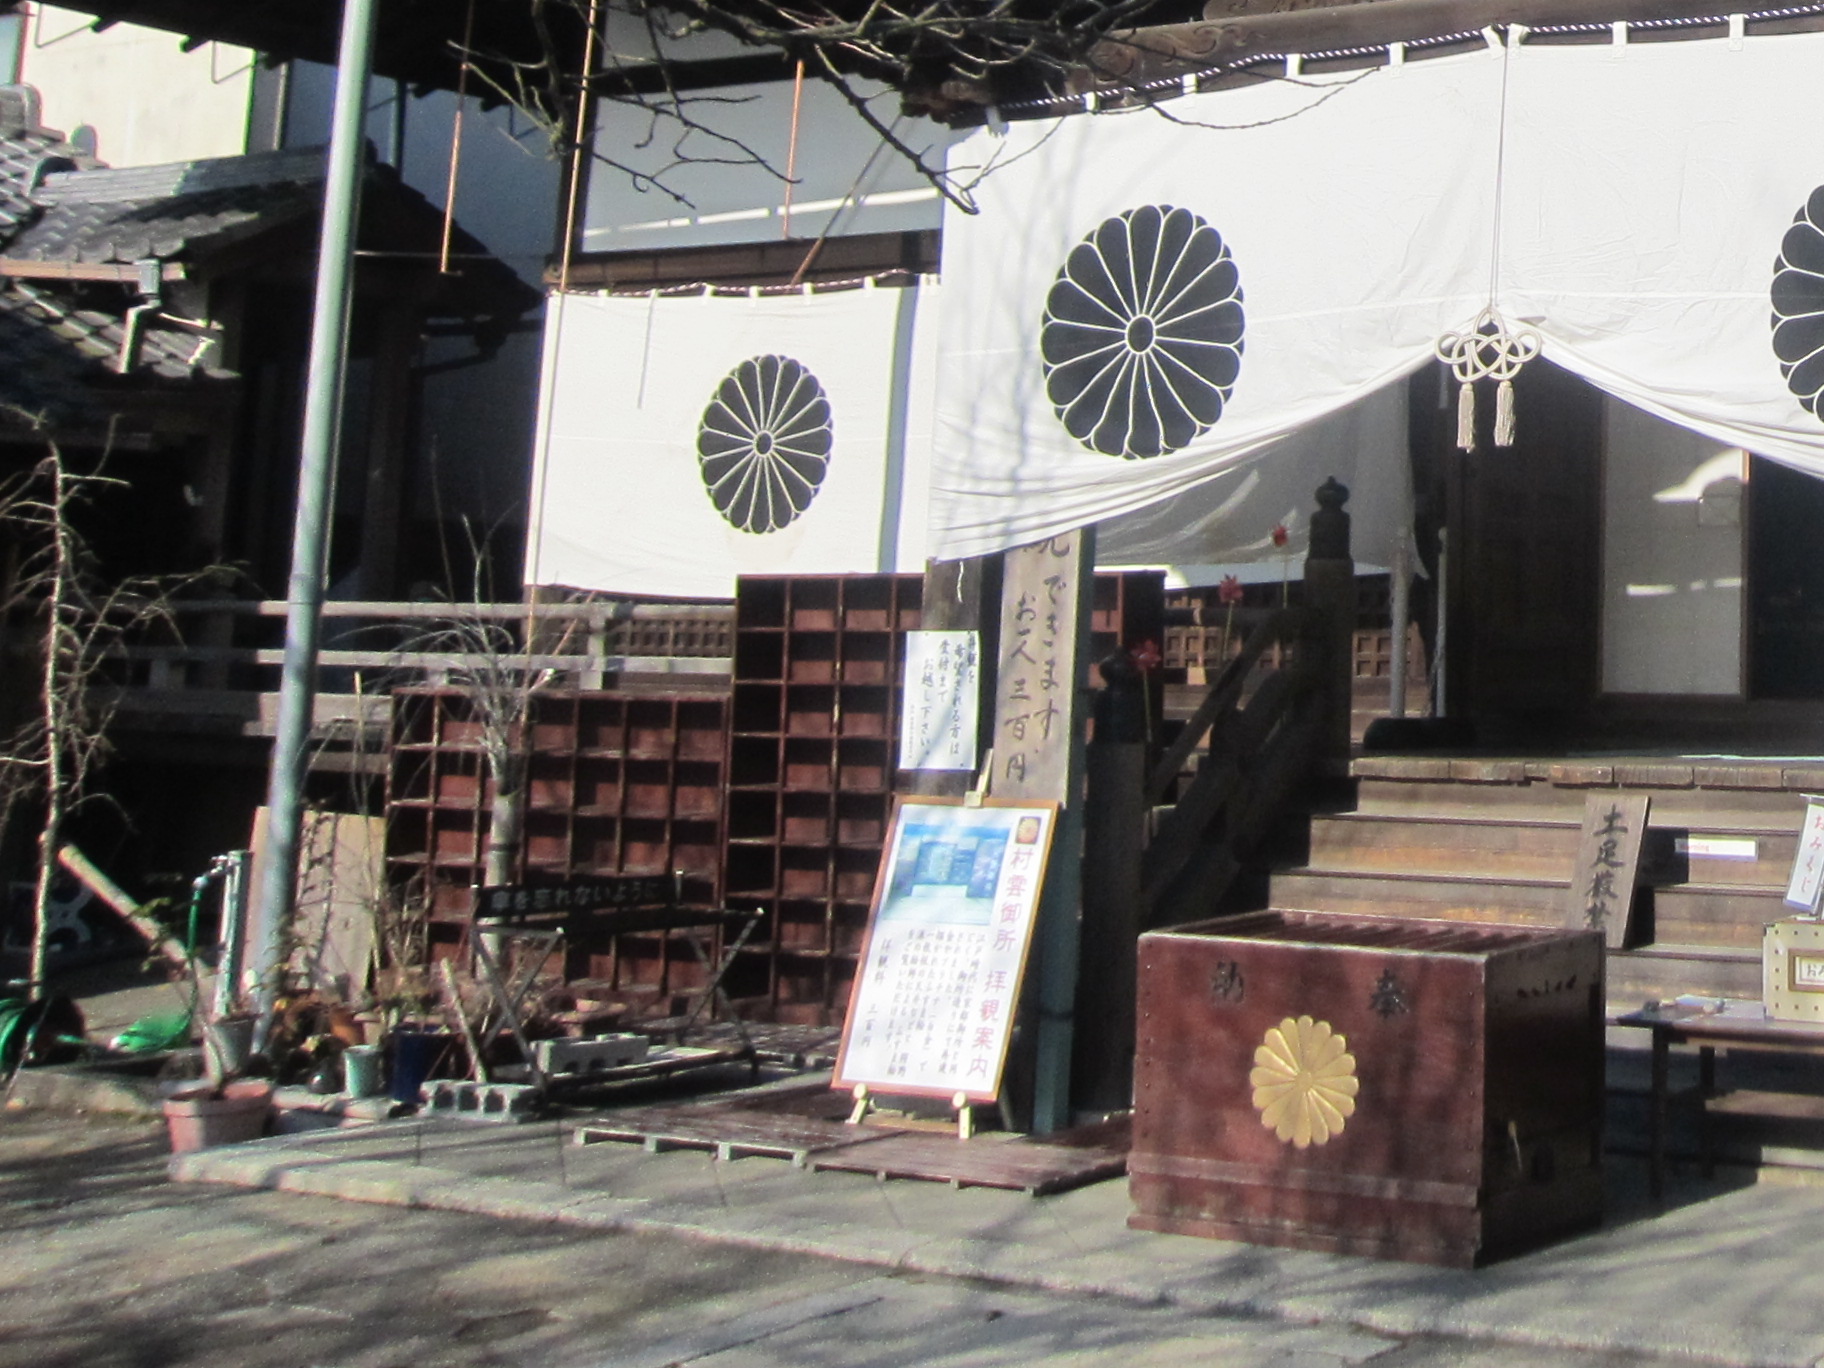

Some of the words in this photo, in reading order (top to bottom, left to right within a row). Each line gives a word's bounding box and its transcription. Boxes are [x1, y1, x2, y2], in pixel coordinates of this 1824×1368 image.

[992, 847, 1035, 954] 村雲御所
[965, 969, 1009, 1080] 拝観案内
